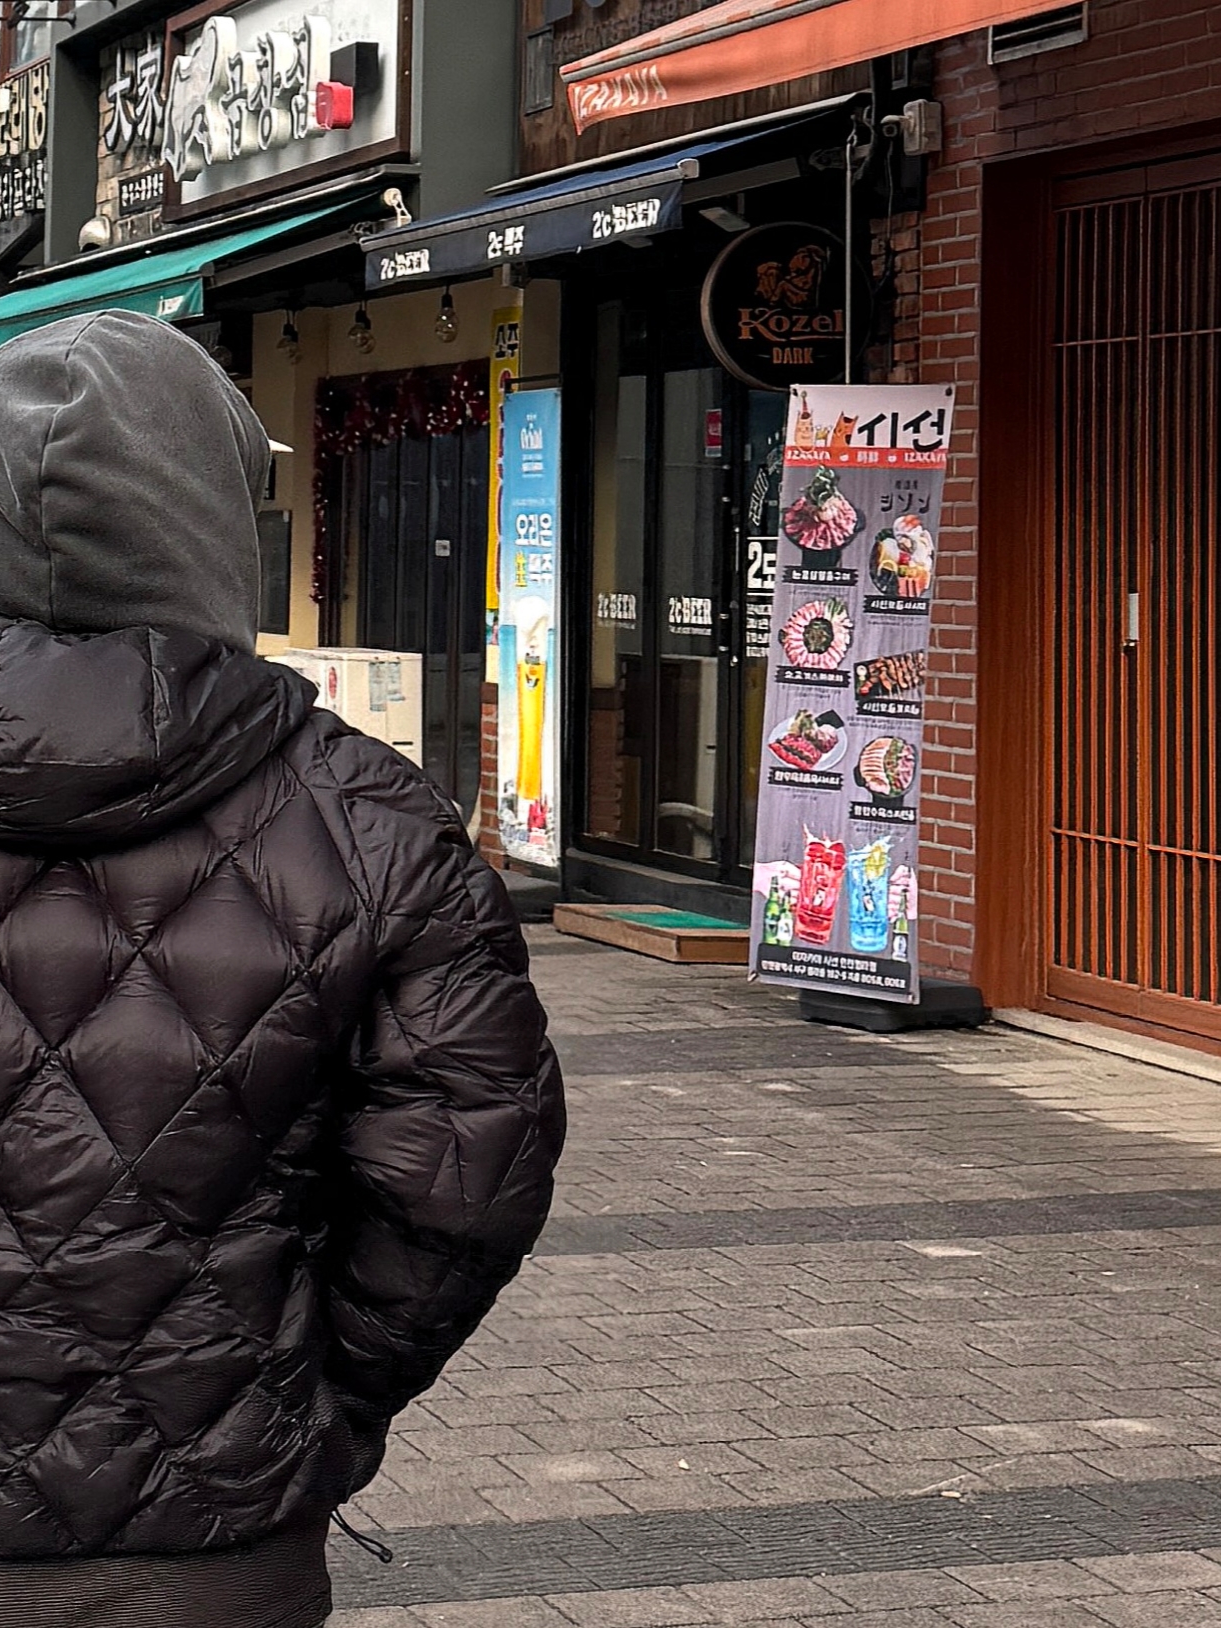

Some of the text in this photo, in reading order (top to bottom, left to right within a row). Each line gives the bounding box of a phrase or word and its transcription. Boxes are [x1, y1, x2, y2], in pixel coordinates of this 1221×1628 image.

[574, 65, 668, 118] IZAKAYA
[738, 308, 844, 342] Kozel
[773, 347, 814, 364] DARK
